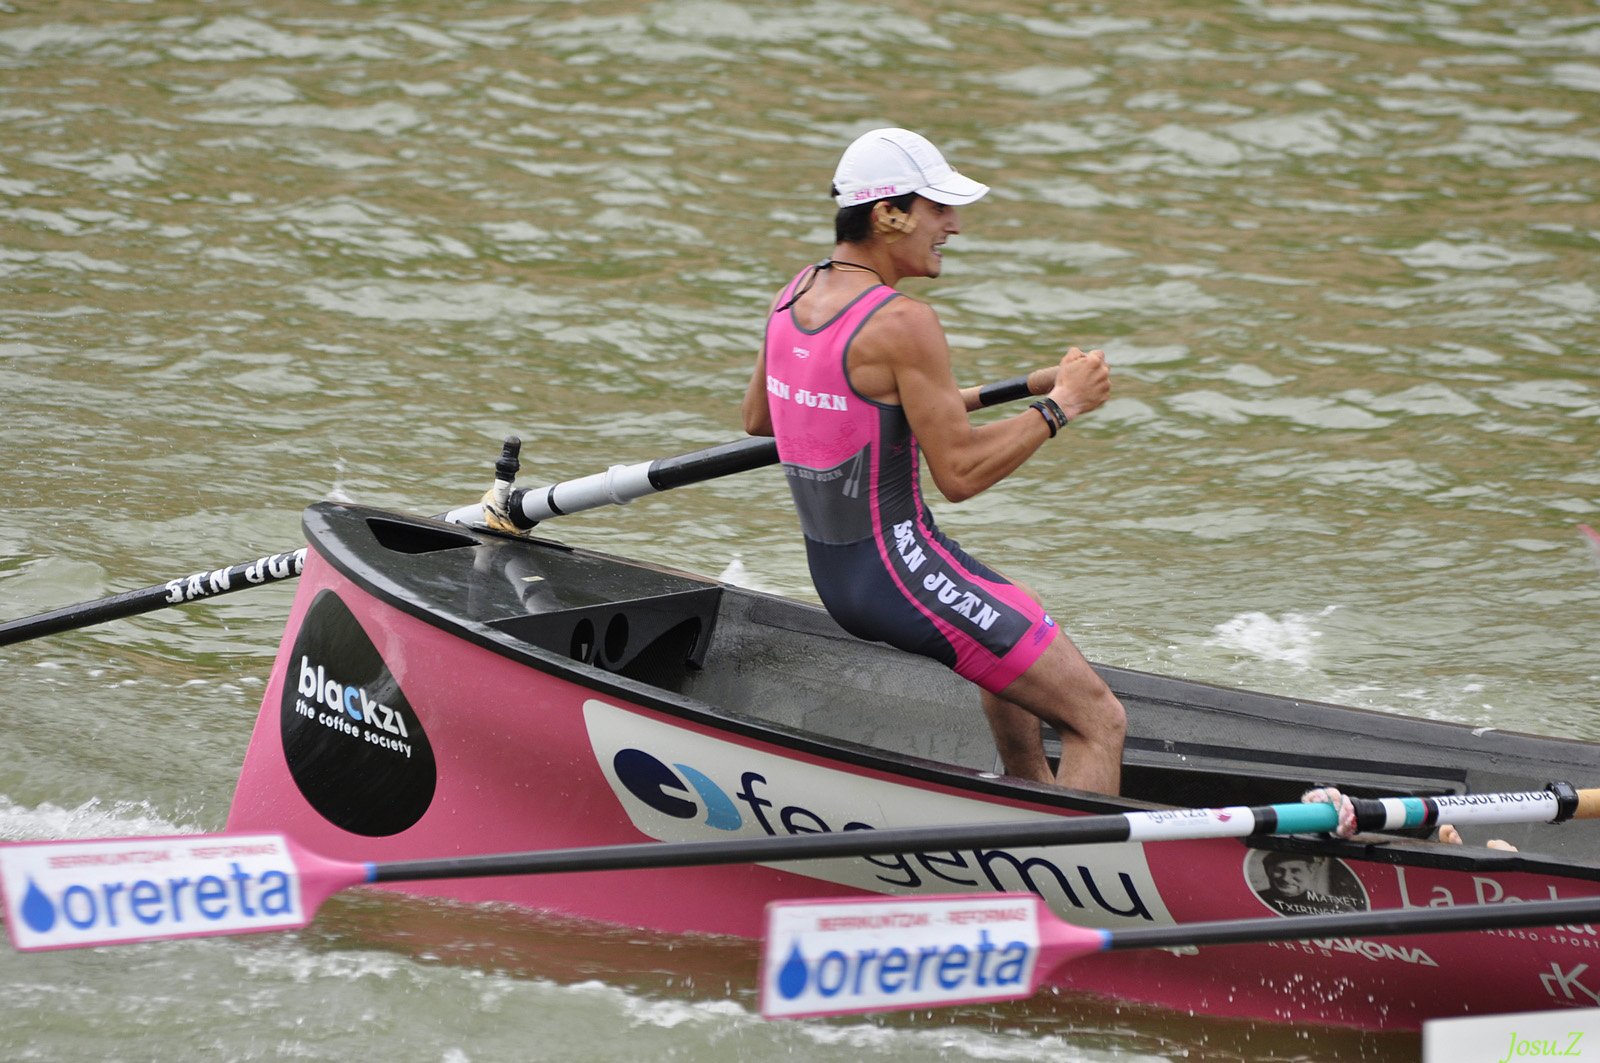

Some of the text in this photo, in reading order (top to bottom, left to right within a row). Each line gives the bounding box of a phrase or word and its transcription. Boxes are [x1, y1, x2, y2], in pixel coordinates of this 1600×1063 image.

[766, 375, 849, 411] SAN JUAN
[165, 565, 234, 604] SAN
[893, 519, 1001, 631] SAN JUAN
[295, 698, 412, 759] the coffee society
[298, 655, 409, 738] blackzi
[1437, 791, 1554, 807] BASQUE MOTOR
[62, 862, 293, 930] orereta
[816, 929, 1029, 998] orereta
